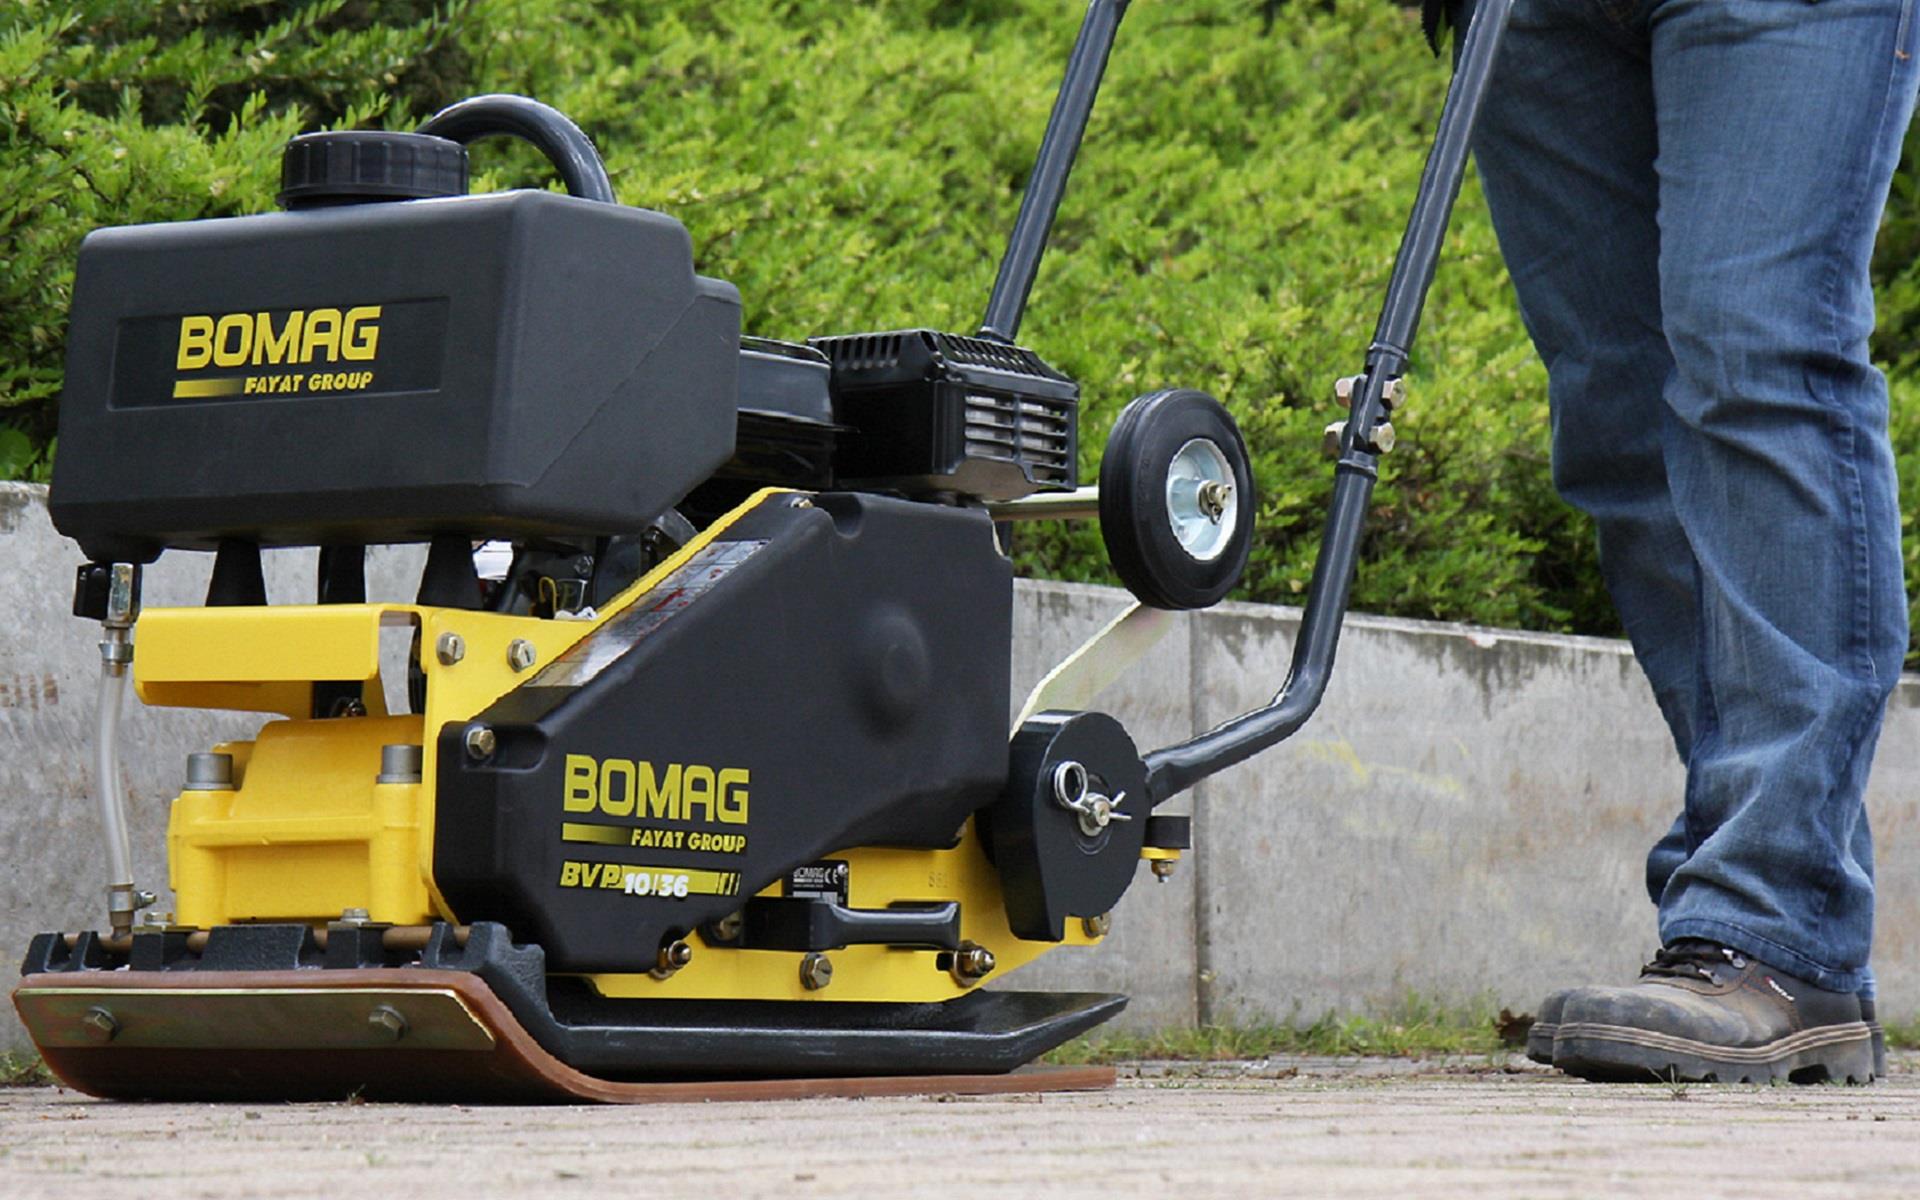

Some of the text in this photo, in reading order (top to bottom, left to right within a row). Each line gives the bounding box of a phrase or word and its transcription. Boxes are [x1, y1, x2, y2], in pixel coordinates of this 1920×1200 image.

[176, 305, 382, 370] BOMAG
[244, 371, 374, 394] FAYAT GROUP
[563, 753, 750, 824] BOMAG
[631, 828, 746, 853] FAYAT GROUP
[559, 860, 623, 888] BVP
